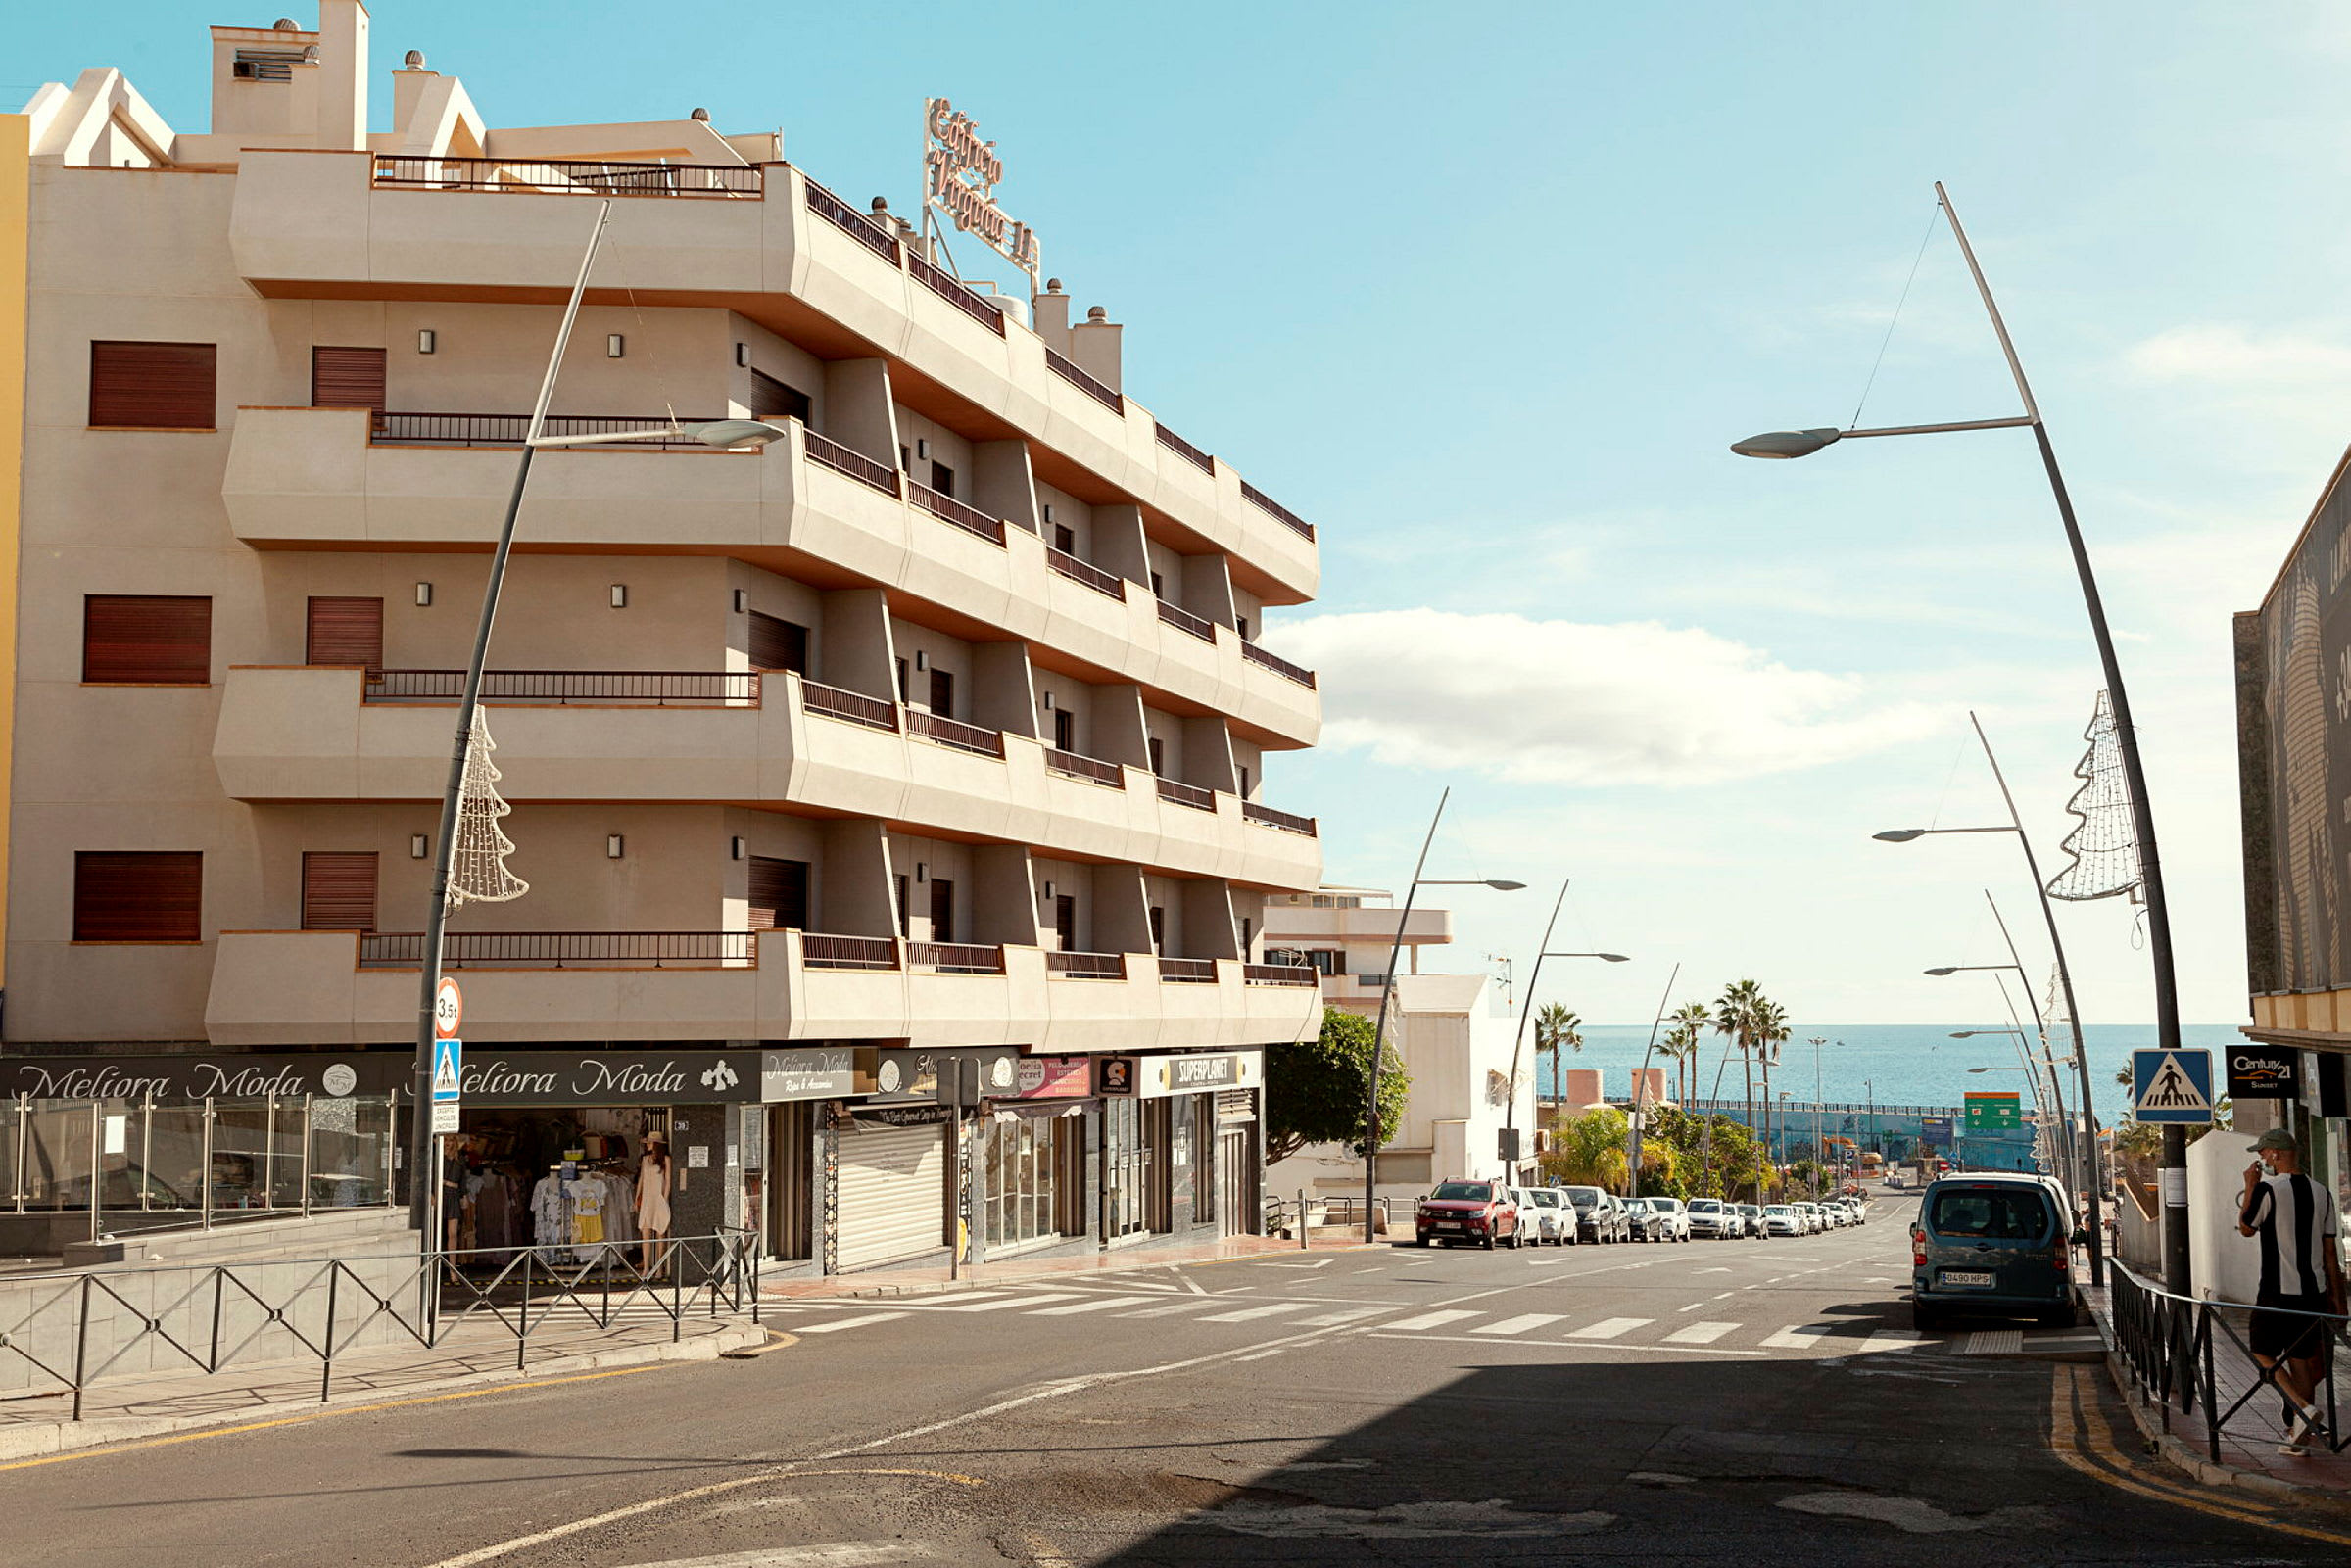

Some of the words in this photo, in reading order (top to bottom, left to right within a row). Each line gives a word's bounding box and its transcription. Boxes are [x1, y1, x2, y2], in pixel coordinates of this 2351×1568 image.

[767, 1055, 813, 1080] Meliora
[816, 1052, 849, 1075] Moda
[1018, 1070, 1041, 1079] ecret
[1020, 1060, 1042, 1070] oelia
[1178, 1058, 1228, 1083] SUPERPLANET
[2233, 1056, 2280, 1070] Century
[2277, 1065, 2291, 1079] 21
[12, 1065, 170, 1099] Meliora
[186, 1064, 305, 1099] Moda
[572, 1060, 687, 1096] Moda
